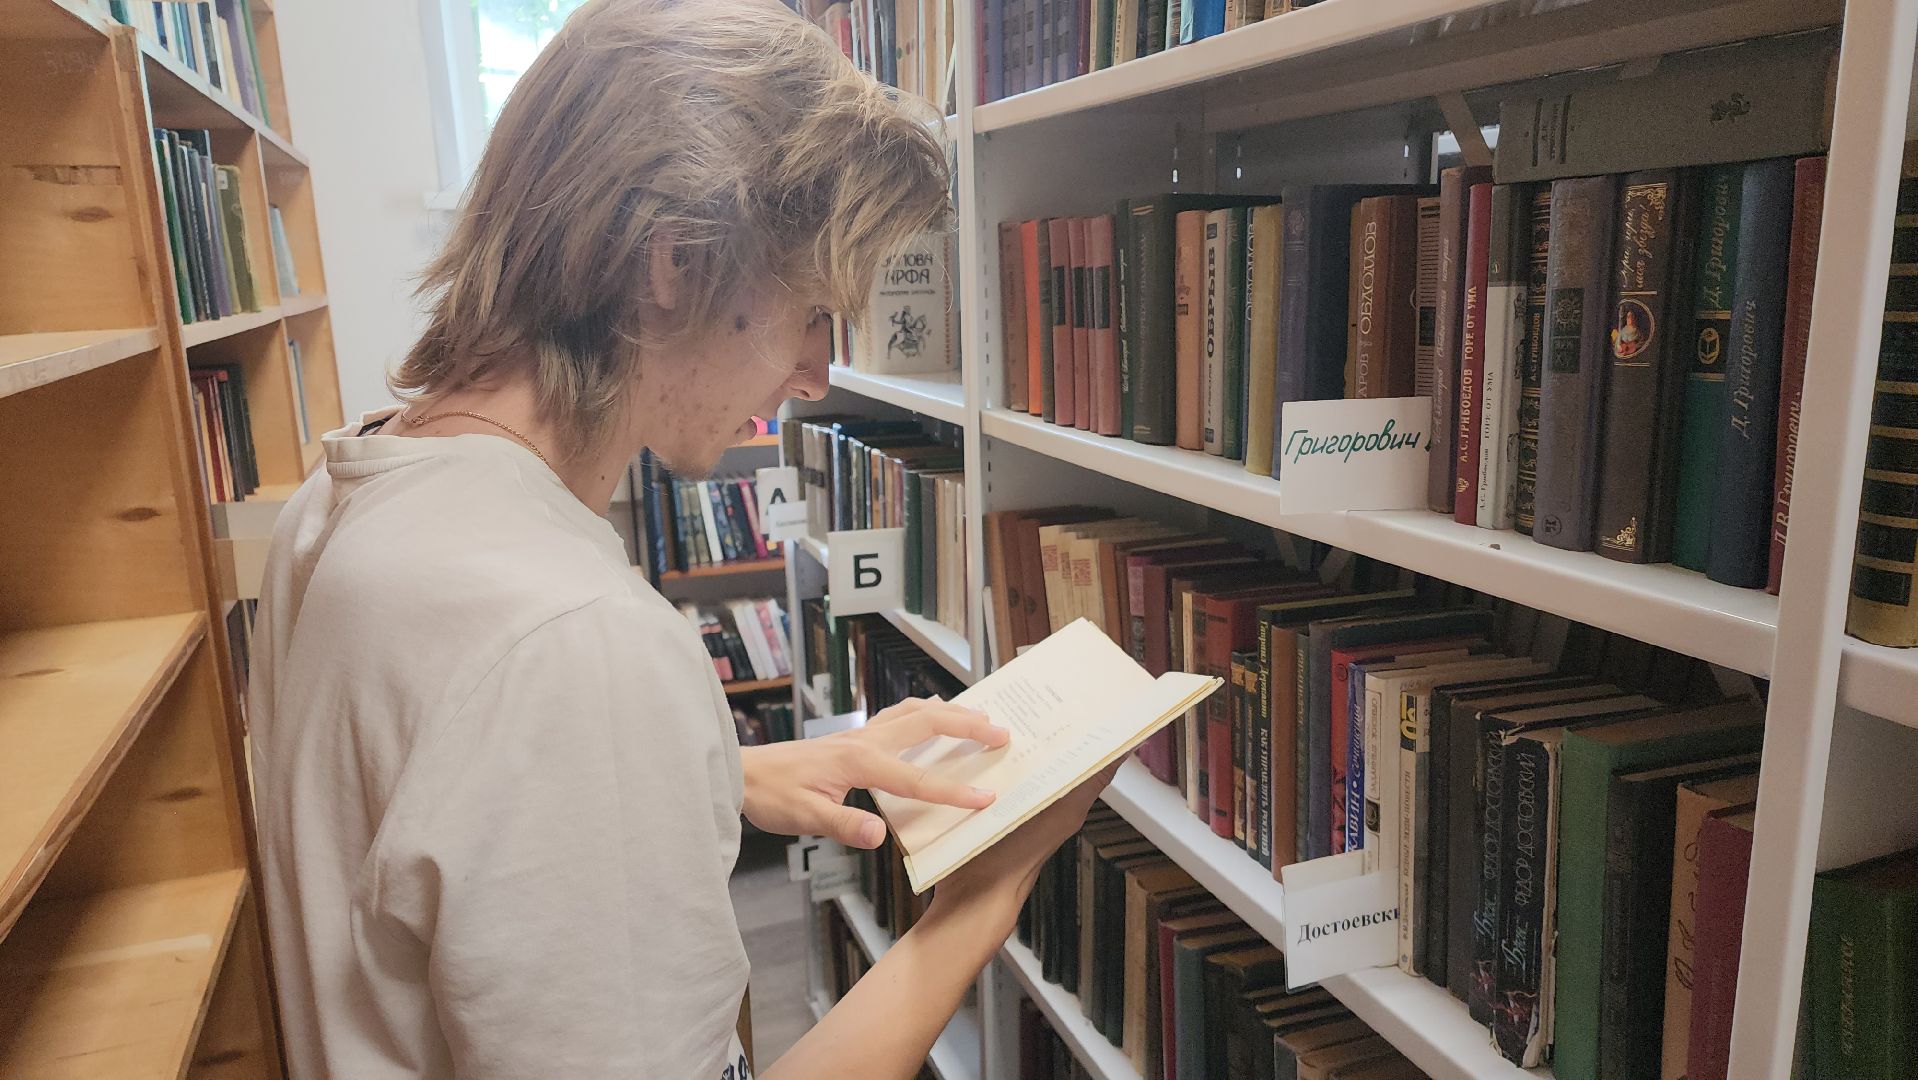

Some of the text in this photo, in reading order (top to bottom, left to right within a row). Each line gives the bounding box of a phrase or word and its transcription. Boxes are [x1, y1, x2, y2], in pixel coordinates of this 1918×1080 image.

[1633, 203, 1656, 258] звезда!
[1704, 174, 1729, 282] Григорович
[1360, 221, 1377, 335] ОБЛОМОВ
[1466, 285, 1477, 310] УМА
[1206, 246, 1216, 358] ОБРЫВ
[1465, 312, 1476, 329] ОТ
[1463, 332, 1475, 361] ГОРЕ
[1730, 299, 1758, 440] Д. Григорович
[1285, 418, 1419, 465] Григорович
[853, 552, 882, 589] Б
[803, 844, 819, 872] Г
